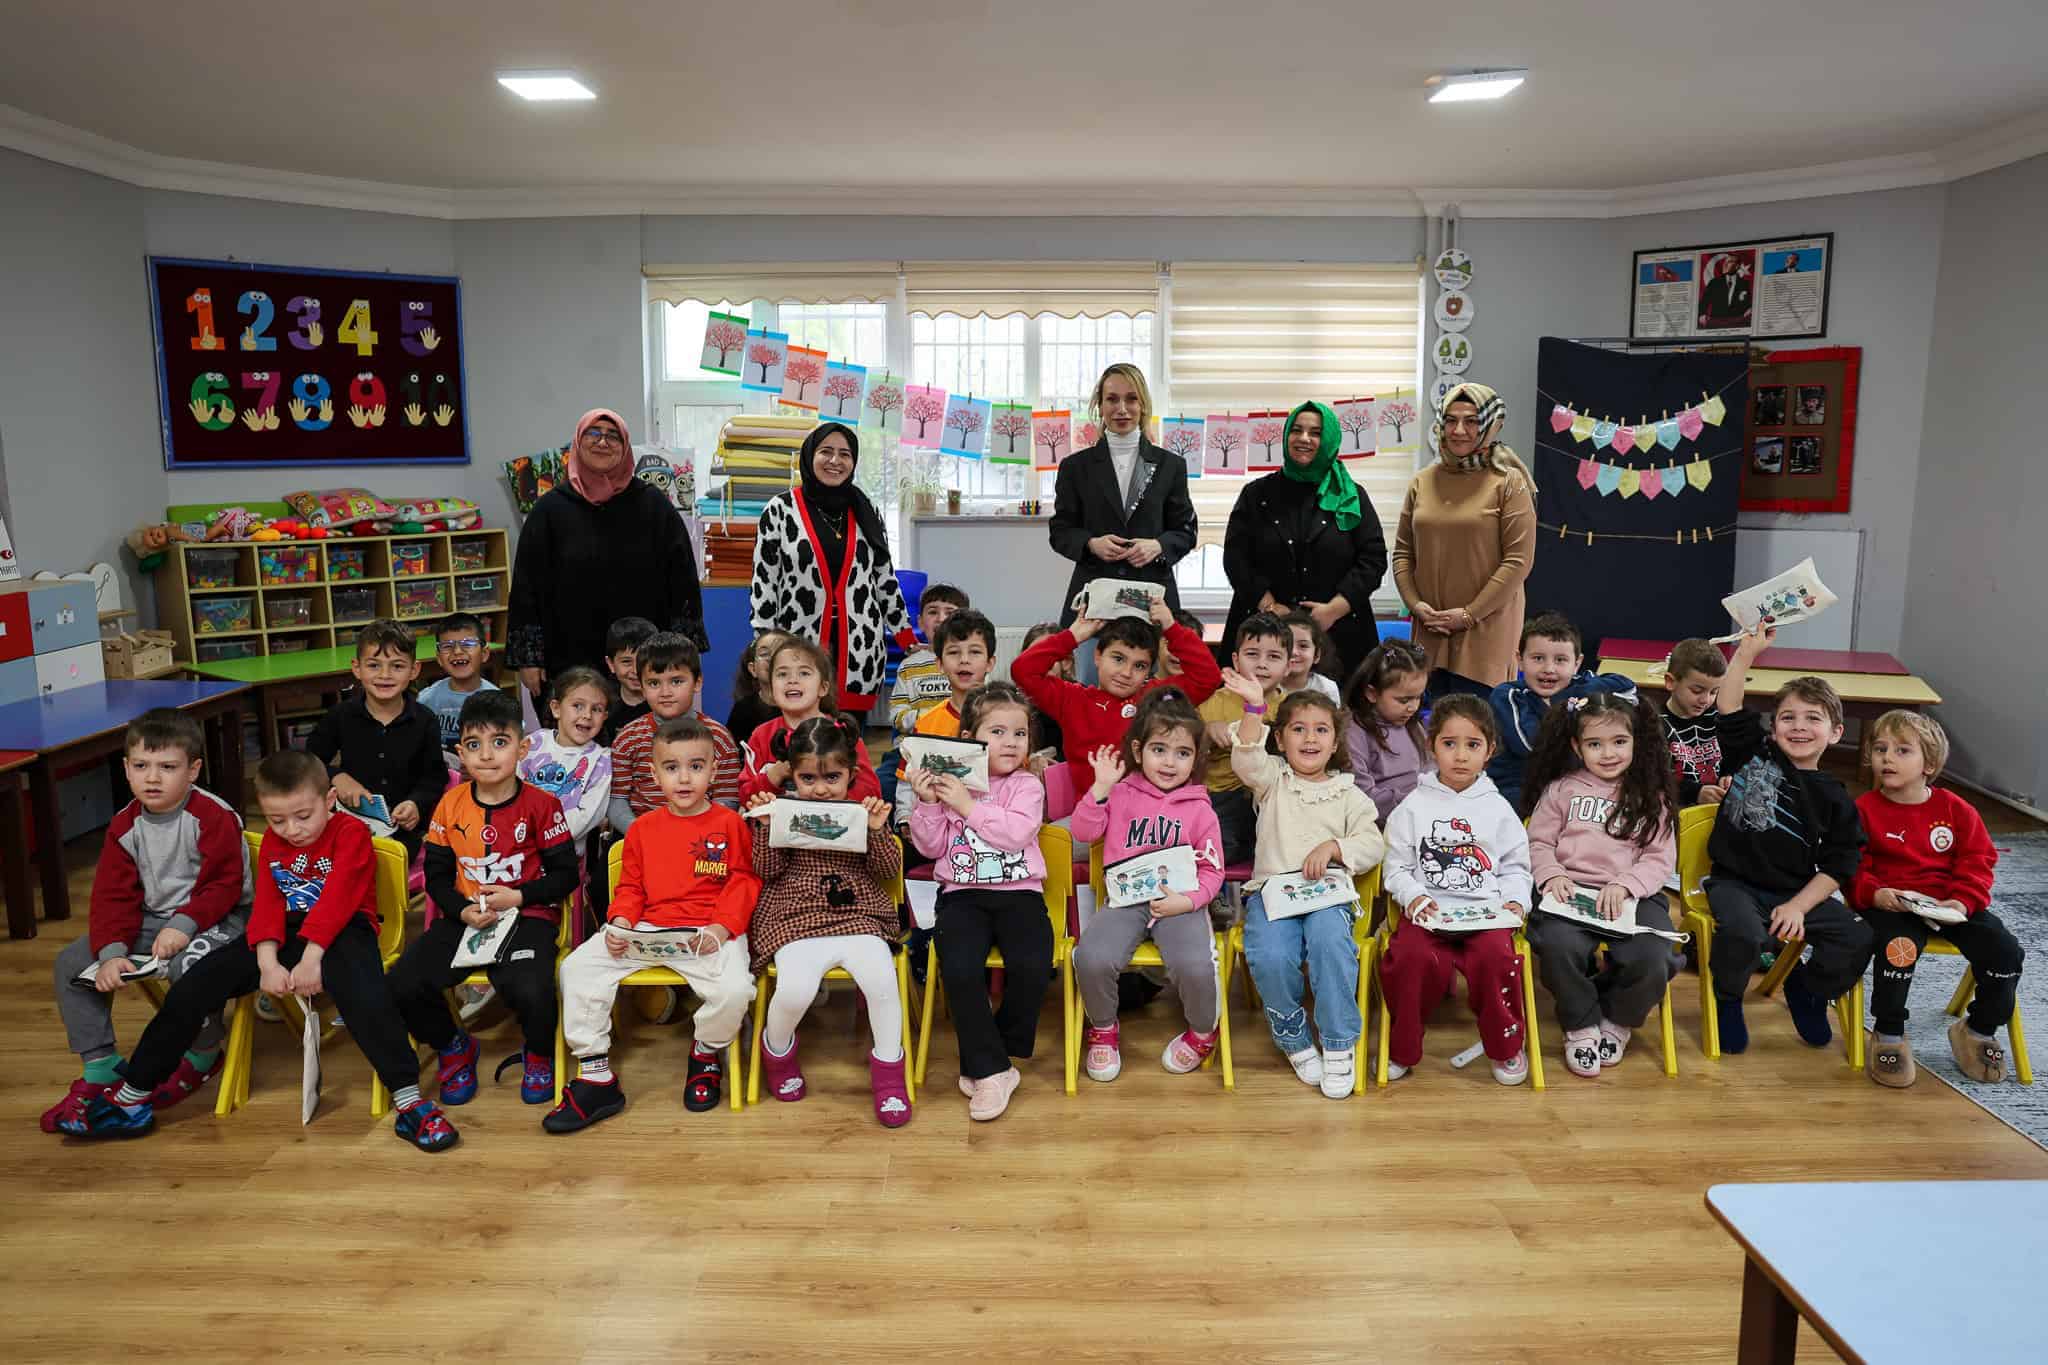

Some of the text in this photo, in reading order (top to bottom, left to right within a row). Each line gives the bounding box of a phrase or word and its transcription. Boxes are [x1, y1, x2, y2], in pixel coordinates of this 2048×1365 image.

[186, 288, 437, 356] 1 2 3 4 5
[191, 372, 235, 431] 6
[241, 371, 281, 431] 7
[293, 373, 331, 431] 8
[350, 371, 386, 429] 9
[694, 860, 728, 876] MARVEL
